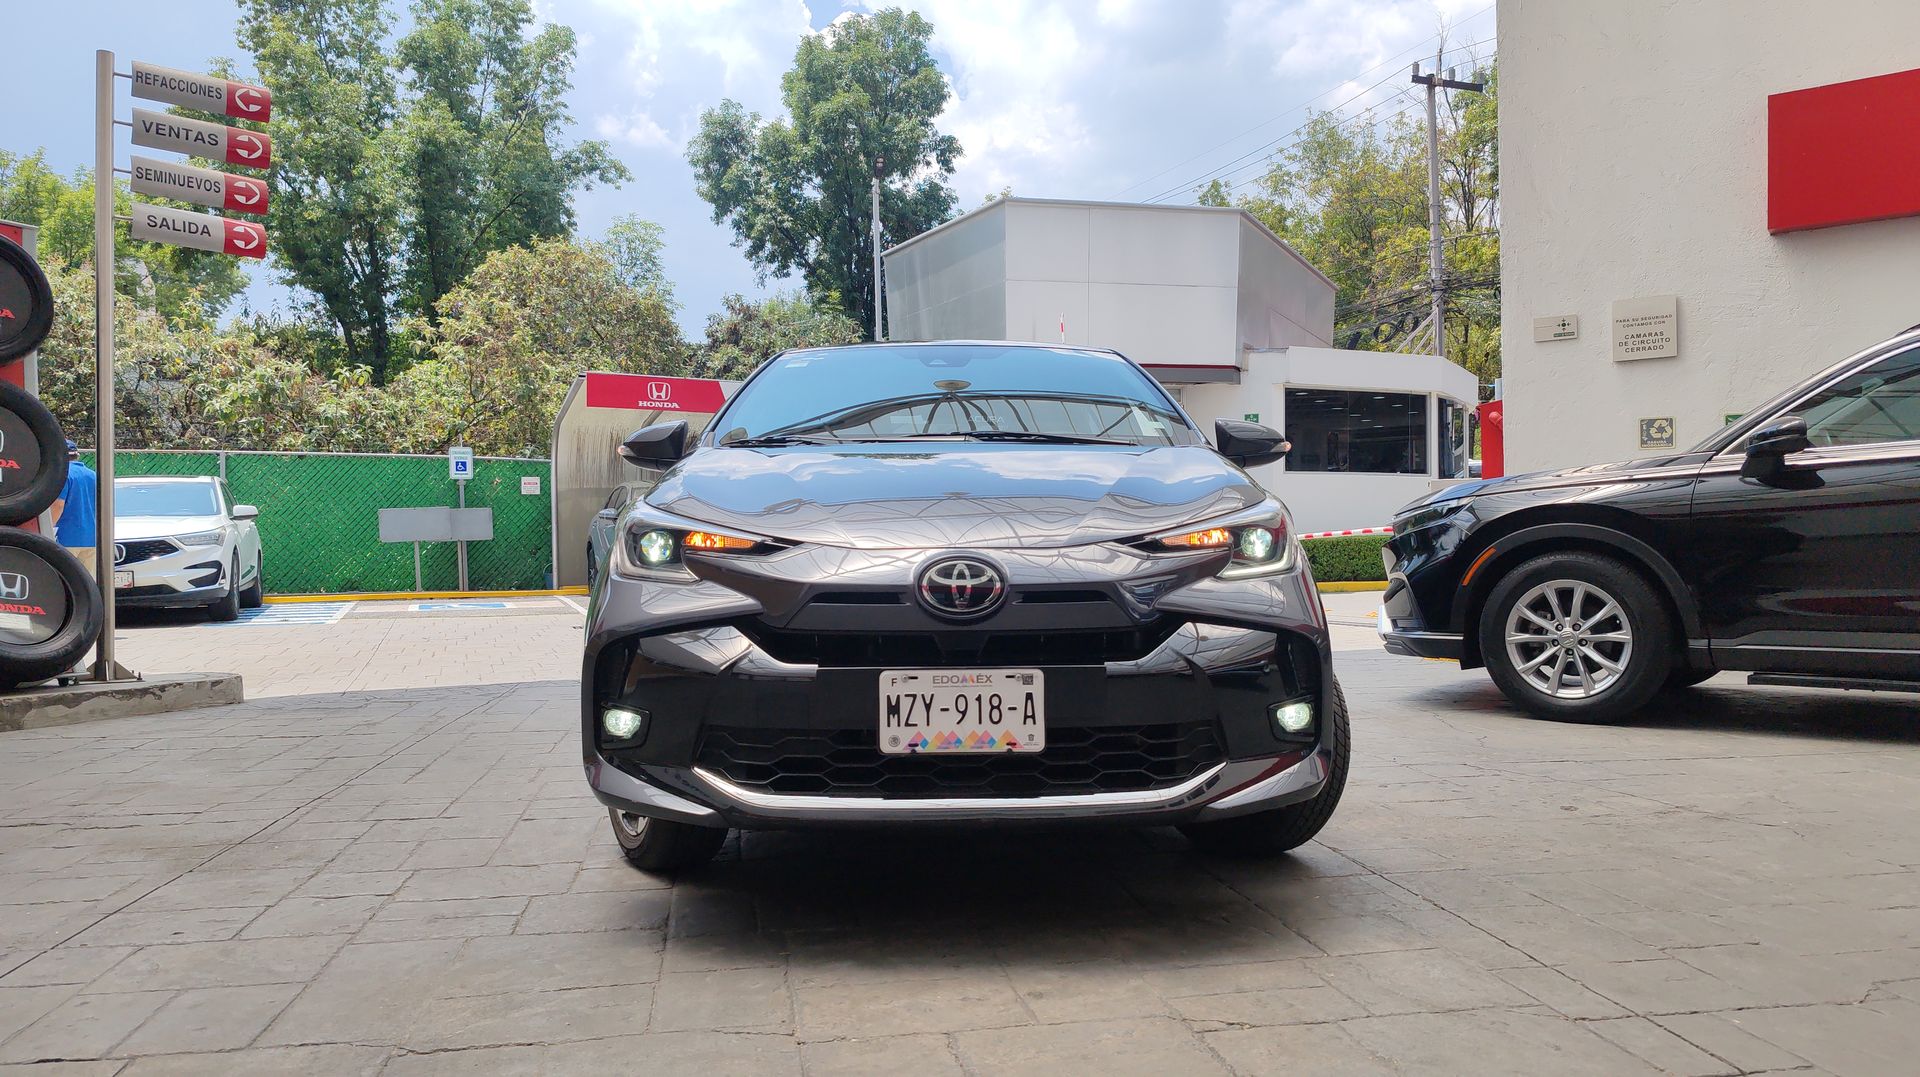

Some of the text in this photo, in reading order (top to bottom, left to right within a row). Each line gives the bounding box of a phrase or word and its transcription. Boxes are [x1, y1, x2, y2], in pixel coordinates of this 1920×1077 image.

[135, 70, 223, 100] REFACCIONES
[141, 119, 219, 146] VENTAS
[135, 166, 221, 194] SEMINUEVOS
[146, 214, 212, 237] SALIDA
[1624, 331, 1664, 340] CAMARAS
[1631, 337, 1671, 346] CIRCUITO
[1624, 344, 1665, 353] CERRADO
[891, 677, 898, 687] F
[886, 691, 1037, 728] MZY-918-A
